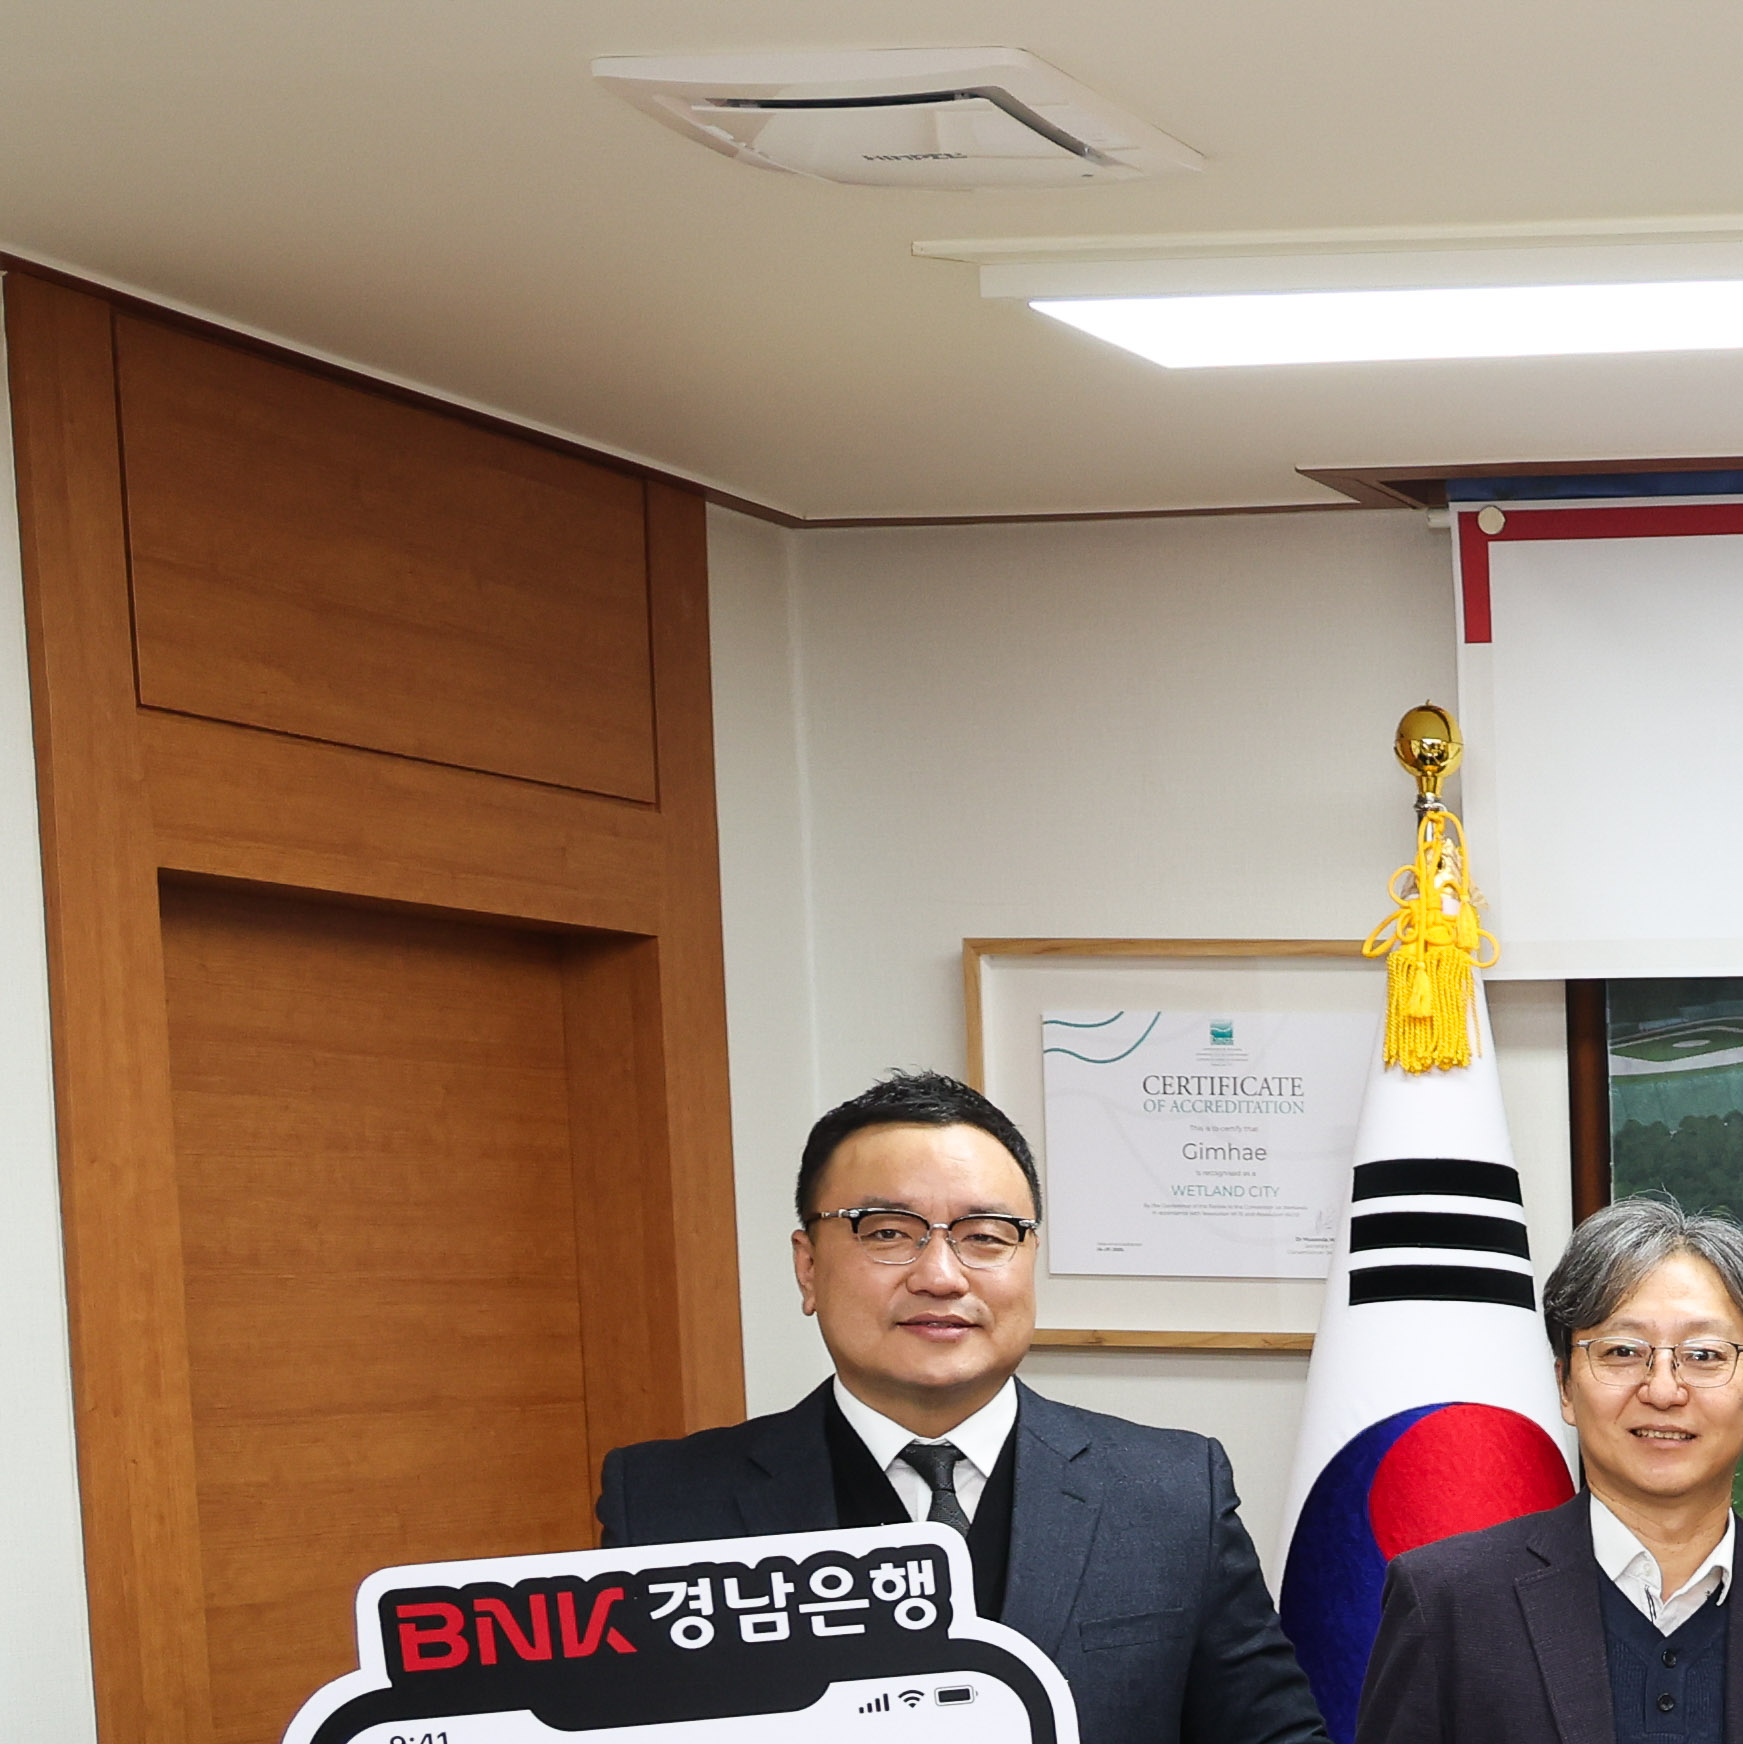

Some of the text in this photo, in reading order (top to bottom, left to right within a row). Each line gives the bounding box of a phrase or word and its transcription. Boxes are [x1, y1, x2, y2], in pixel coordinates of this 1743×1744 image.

[1142, 1075, 1305, 1097] CERTIFICATE
[1143, 1099, 1305, 1114] OF ACCREDITATION
[1182, 1142, 1267, 1161] Gimhae
[1171, 1185, 1280, 1198] WETLAND CITY
[395, 1558, 938, 1673] BNK 경남은행
